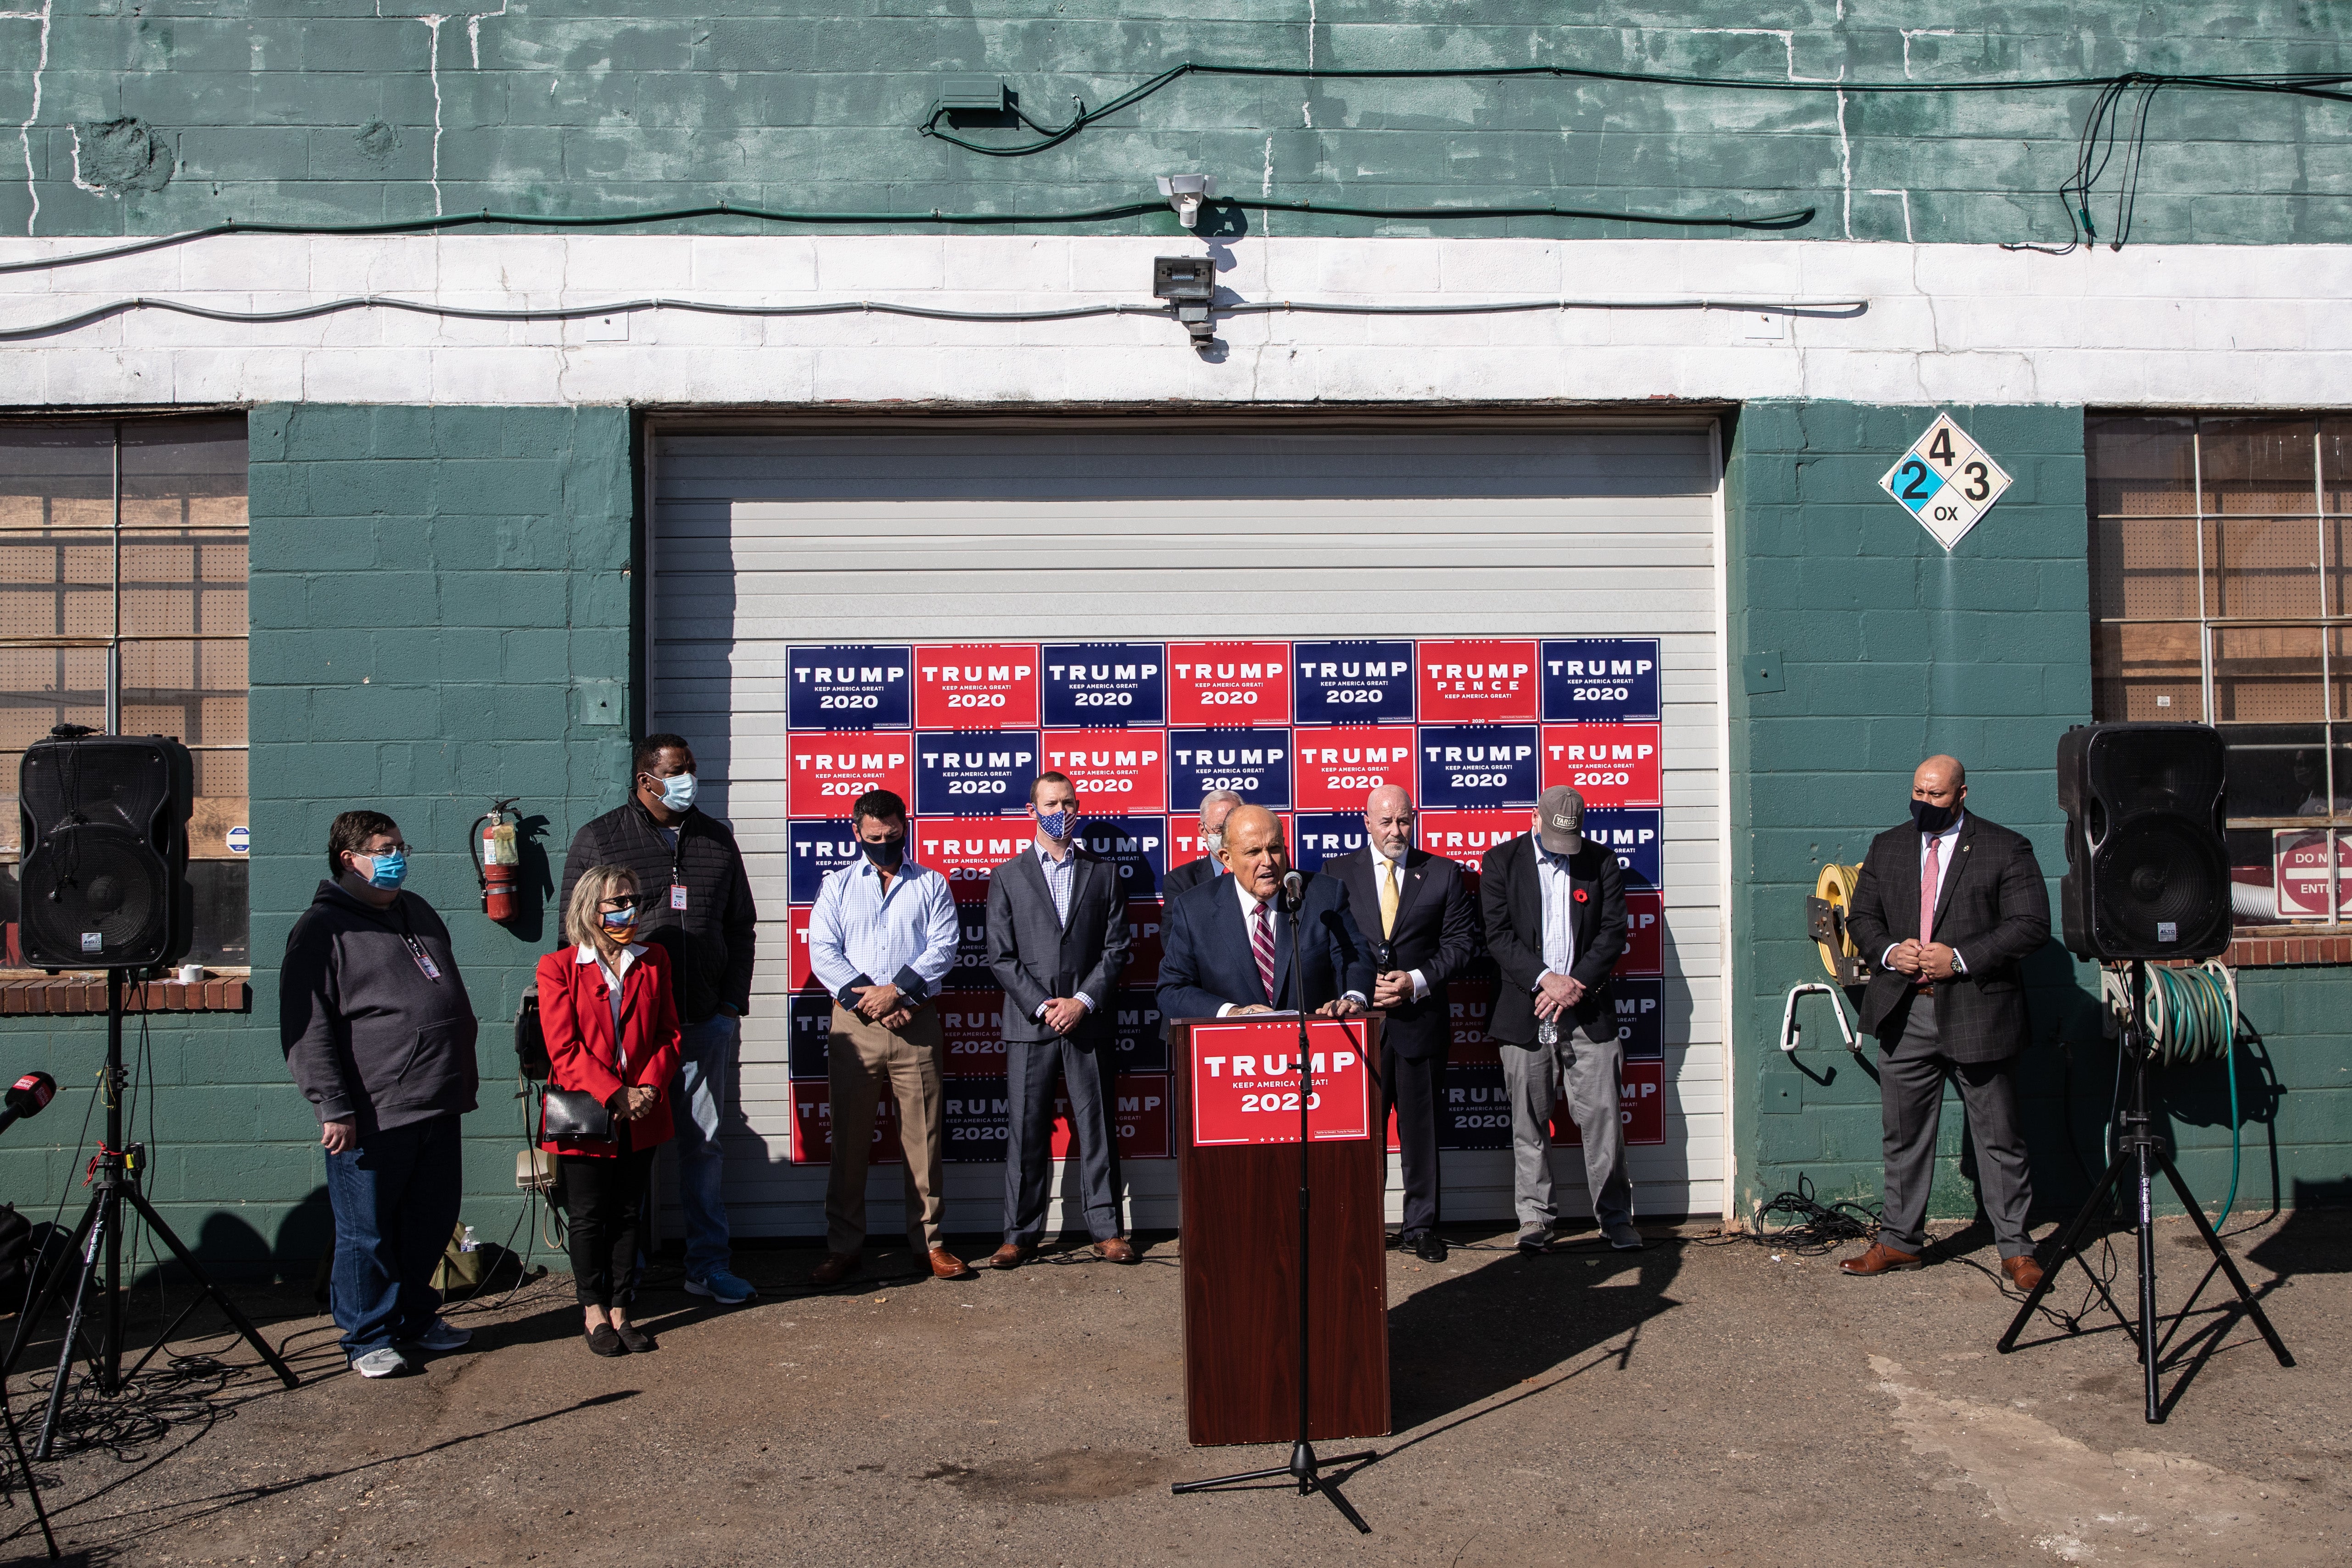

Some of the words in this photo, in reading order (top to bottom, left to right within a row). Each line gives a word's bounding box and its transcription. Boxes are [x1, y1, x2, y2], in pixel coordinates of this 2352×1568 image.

[1929, 428, 1955, 466] 4
[1901, 460, 1927, 499] 2
[1965, 462, 1989, 501] 3
[1934, 507, 1958, 521] OX
[922, 666, 1030, 681] TRUMP
[1050, 665, 1157, 680] TRUMP
[1175, 664, 1282, 679] TRUMP
[1301, 662, 1407, 677] TRUMP
[1428, 664, 1528, 678] TRUMP
[1548, 660, 1652, 675] TRUMP
[795, 668, 904, 682] TRUMP
[1437, 681, 1519, 690] PENCE
[949, 694, 1005, 707] 2020
[1075, 693, 1132, 705] 2020
[1201, 692, 1257, 704] 2020
[1327, 690, 1382, 703] 2020
[1574, 688, 1628, 700] 2020
[821, 696, 878, 708] 2020
[1050, 751, 1157, 766] TRUMP
[1176, 749, 1283, 764] TRUMP
[1302, 748, 1408, 763] TRUMP
[1426, 746, 1531, 761] TRUMP
[1549, 745, 1653, 760] TRUMP
[796, 754, 904, 769] TRUMP
[923, 753, 1031, 768] TRUMP
[1076, 779, 1132, 792] 2020
[1202, 777, 1258, 791] 2020
[1328, 776, 1383, 789] 2020
[1452, 774, 1507, 787] 2020
[1574, 772, 1629, 785] 2020
[949, 781, 1006, 793] 2020
[1557, 817, 1575, 825] YARDS
[1073, 837, 1159, 853] RUMP
[1427, 831, 1527, 847] TRUM
[796, 842, 856, 857] TRU
[923, 839, 1032, 855] TRUMP
[2296, 854, 2314, 863] DO
[2318, 853, 2345, 863] NT
[950, 867, 991, 880] 202
[954, 954, 990, 967] 202
[951, 1040, 1006, 1054] 2020
[1204, 1051, 1355, 1077] TRUMP
[946, 1099, 1009, 1114] RUM
[1241, 1093, 1320, 1112] 2020
[1455, 1115, 1510, 1128] 2020
[951, 1127, 1009, 1140] 2020
[86, 1244, 98, 1263] Stands
